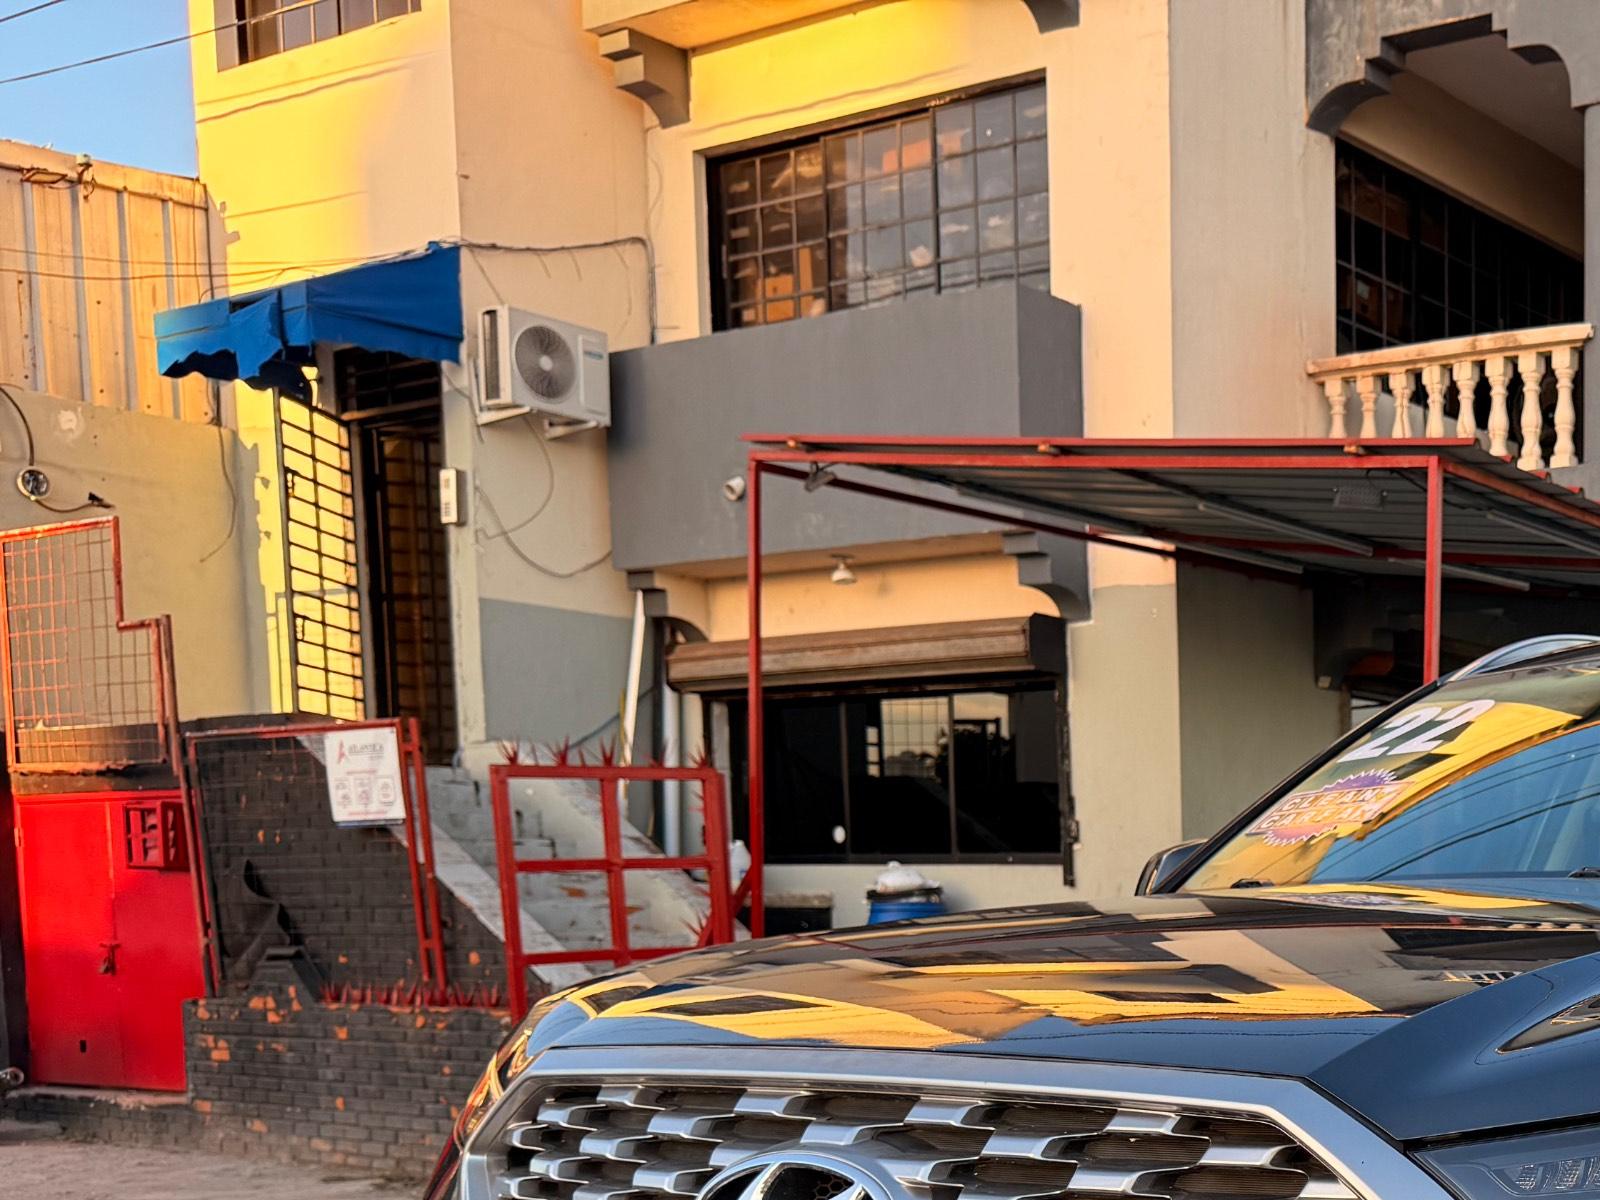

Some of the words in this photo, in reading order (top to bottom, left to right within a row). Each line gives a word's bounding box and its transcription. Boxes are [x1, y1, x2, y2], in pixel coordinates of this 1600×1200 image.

[1337, 699, 1496, 763] 22
[1281, 788, 1380, 812] CLEAN
[1260, 804, 1380, 829] CARFAX
